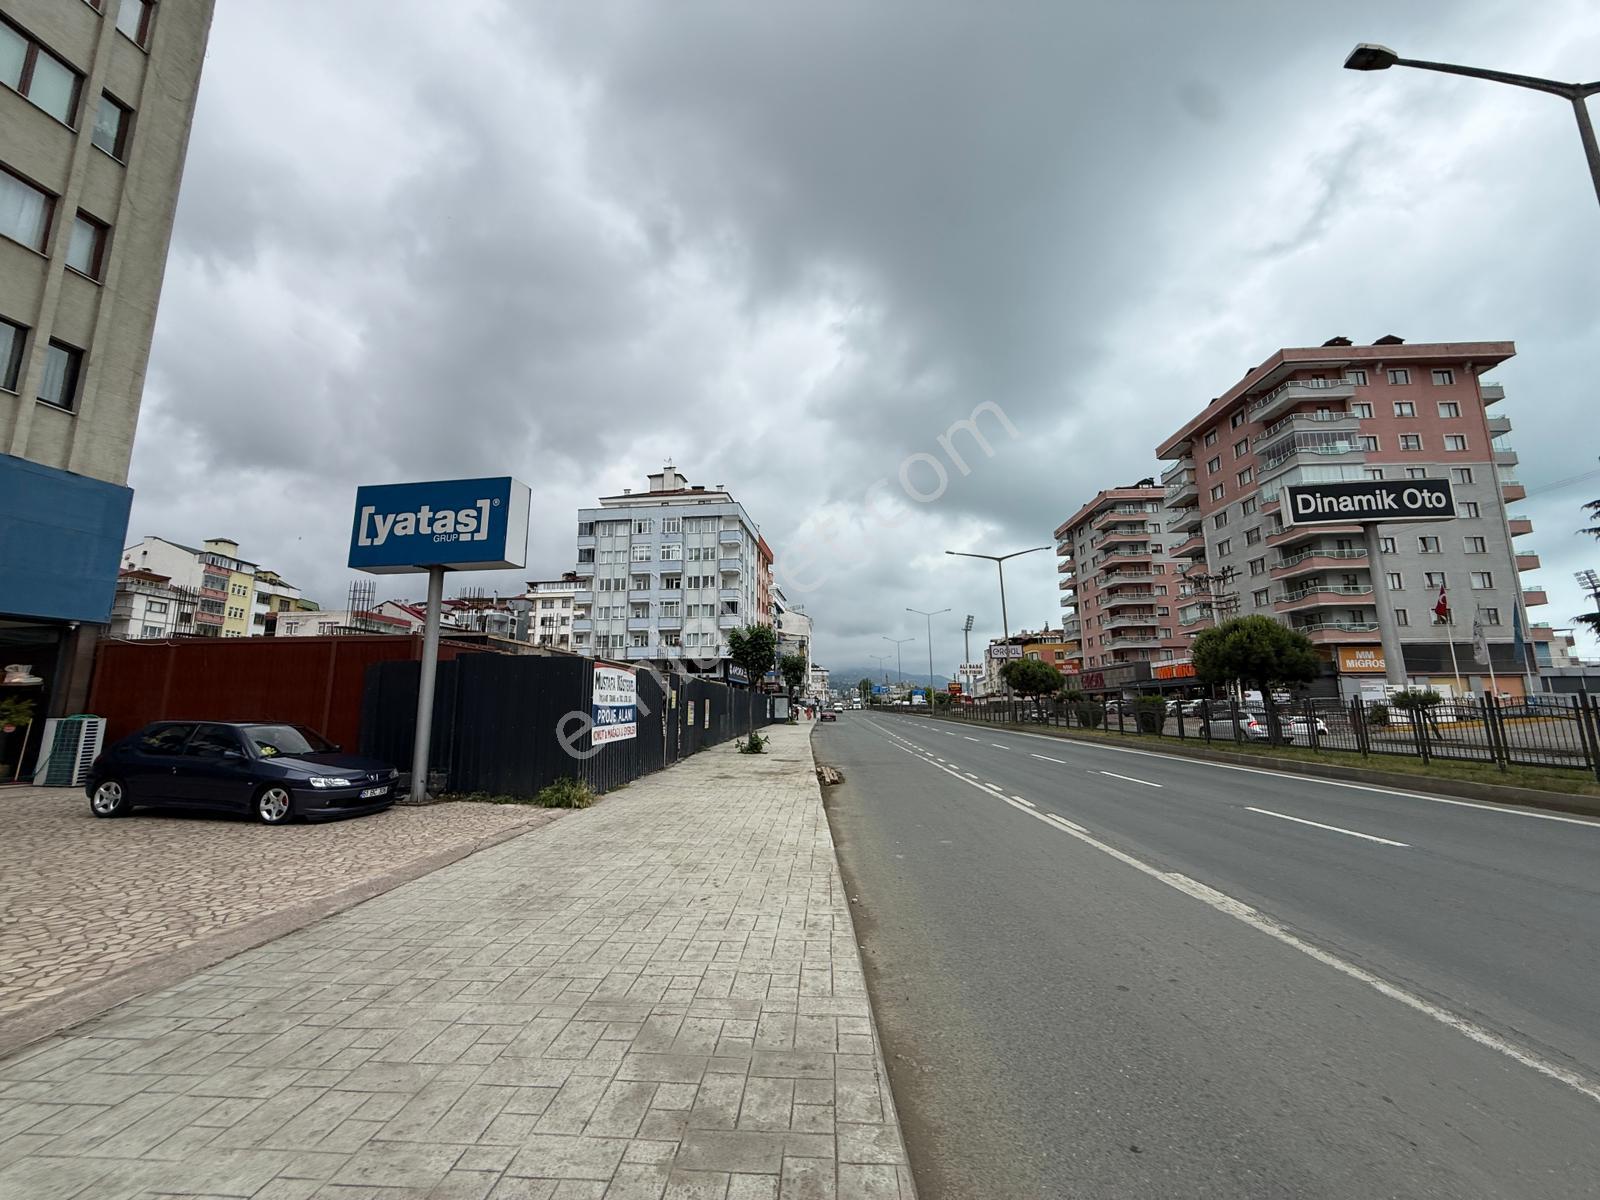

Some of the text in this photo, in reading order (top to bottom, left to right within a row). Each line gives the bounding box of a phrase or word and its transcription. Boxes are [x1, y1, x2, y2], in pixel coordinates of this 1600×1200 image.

[1296, 488, 1447, 515] Dinamik Oto
[433, 533, 459, 543] GRUP
[597, 709, 617, 724] PROJE
